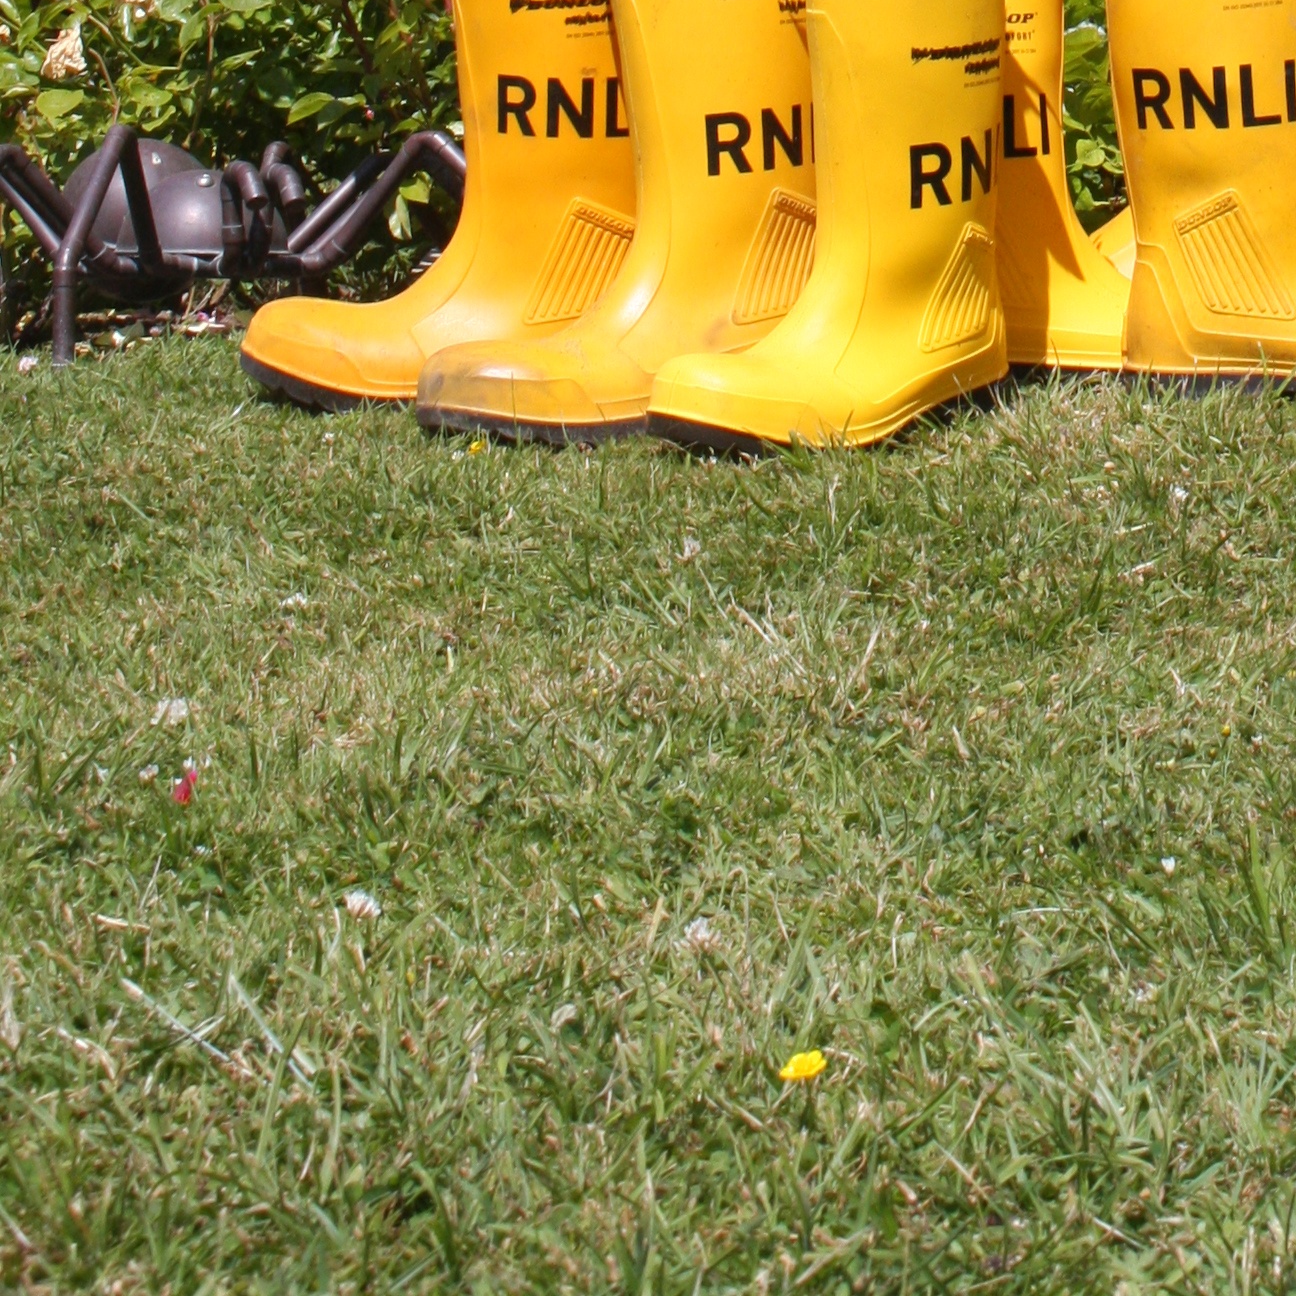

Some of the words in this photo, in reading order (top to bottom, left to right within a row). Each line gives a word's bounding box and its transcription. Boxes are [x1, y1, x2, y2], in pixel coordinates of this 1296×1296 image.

[498, 74, 630, 138] RNL
[1003, 93, 1050, 158] LI
[705, 102, 815, 177] RN
[909, 122, 1000, 209] RN
[1179, 196, 1232, 231] DUNLOP
